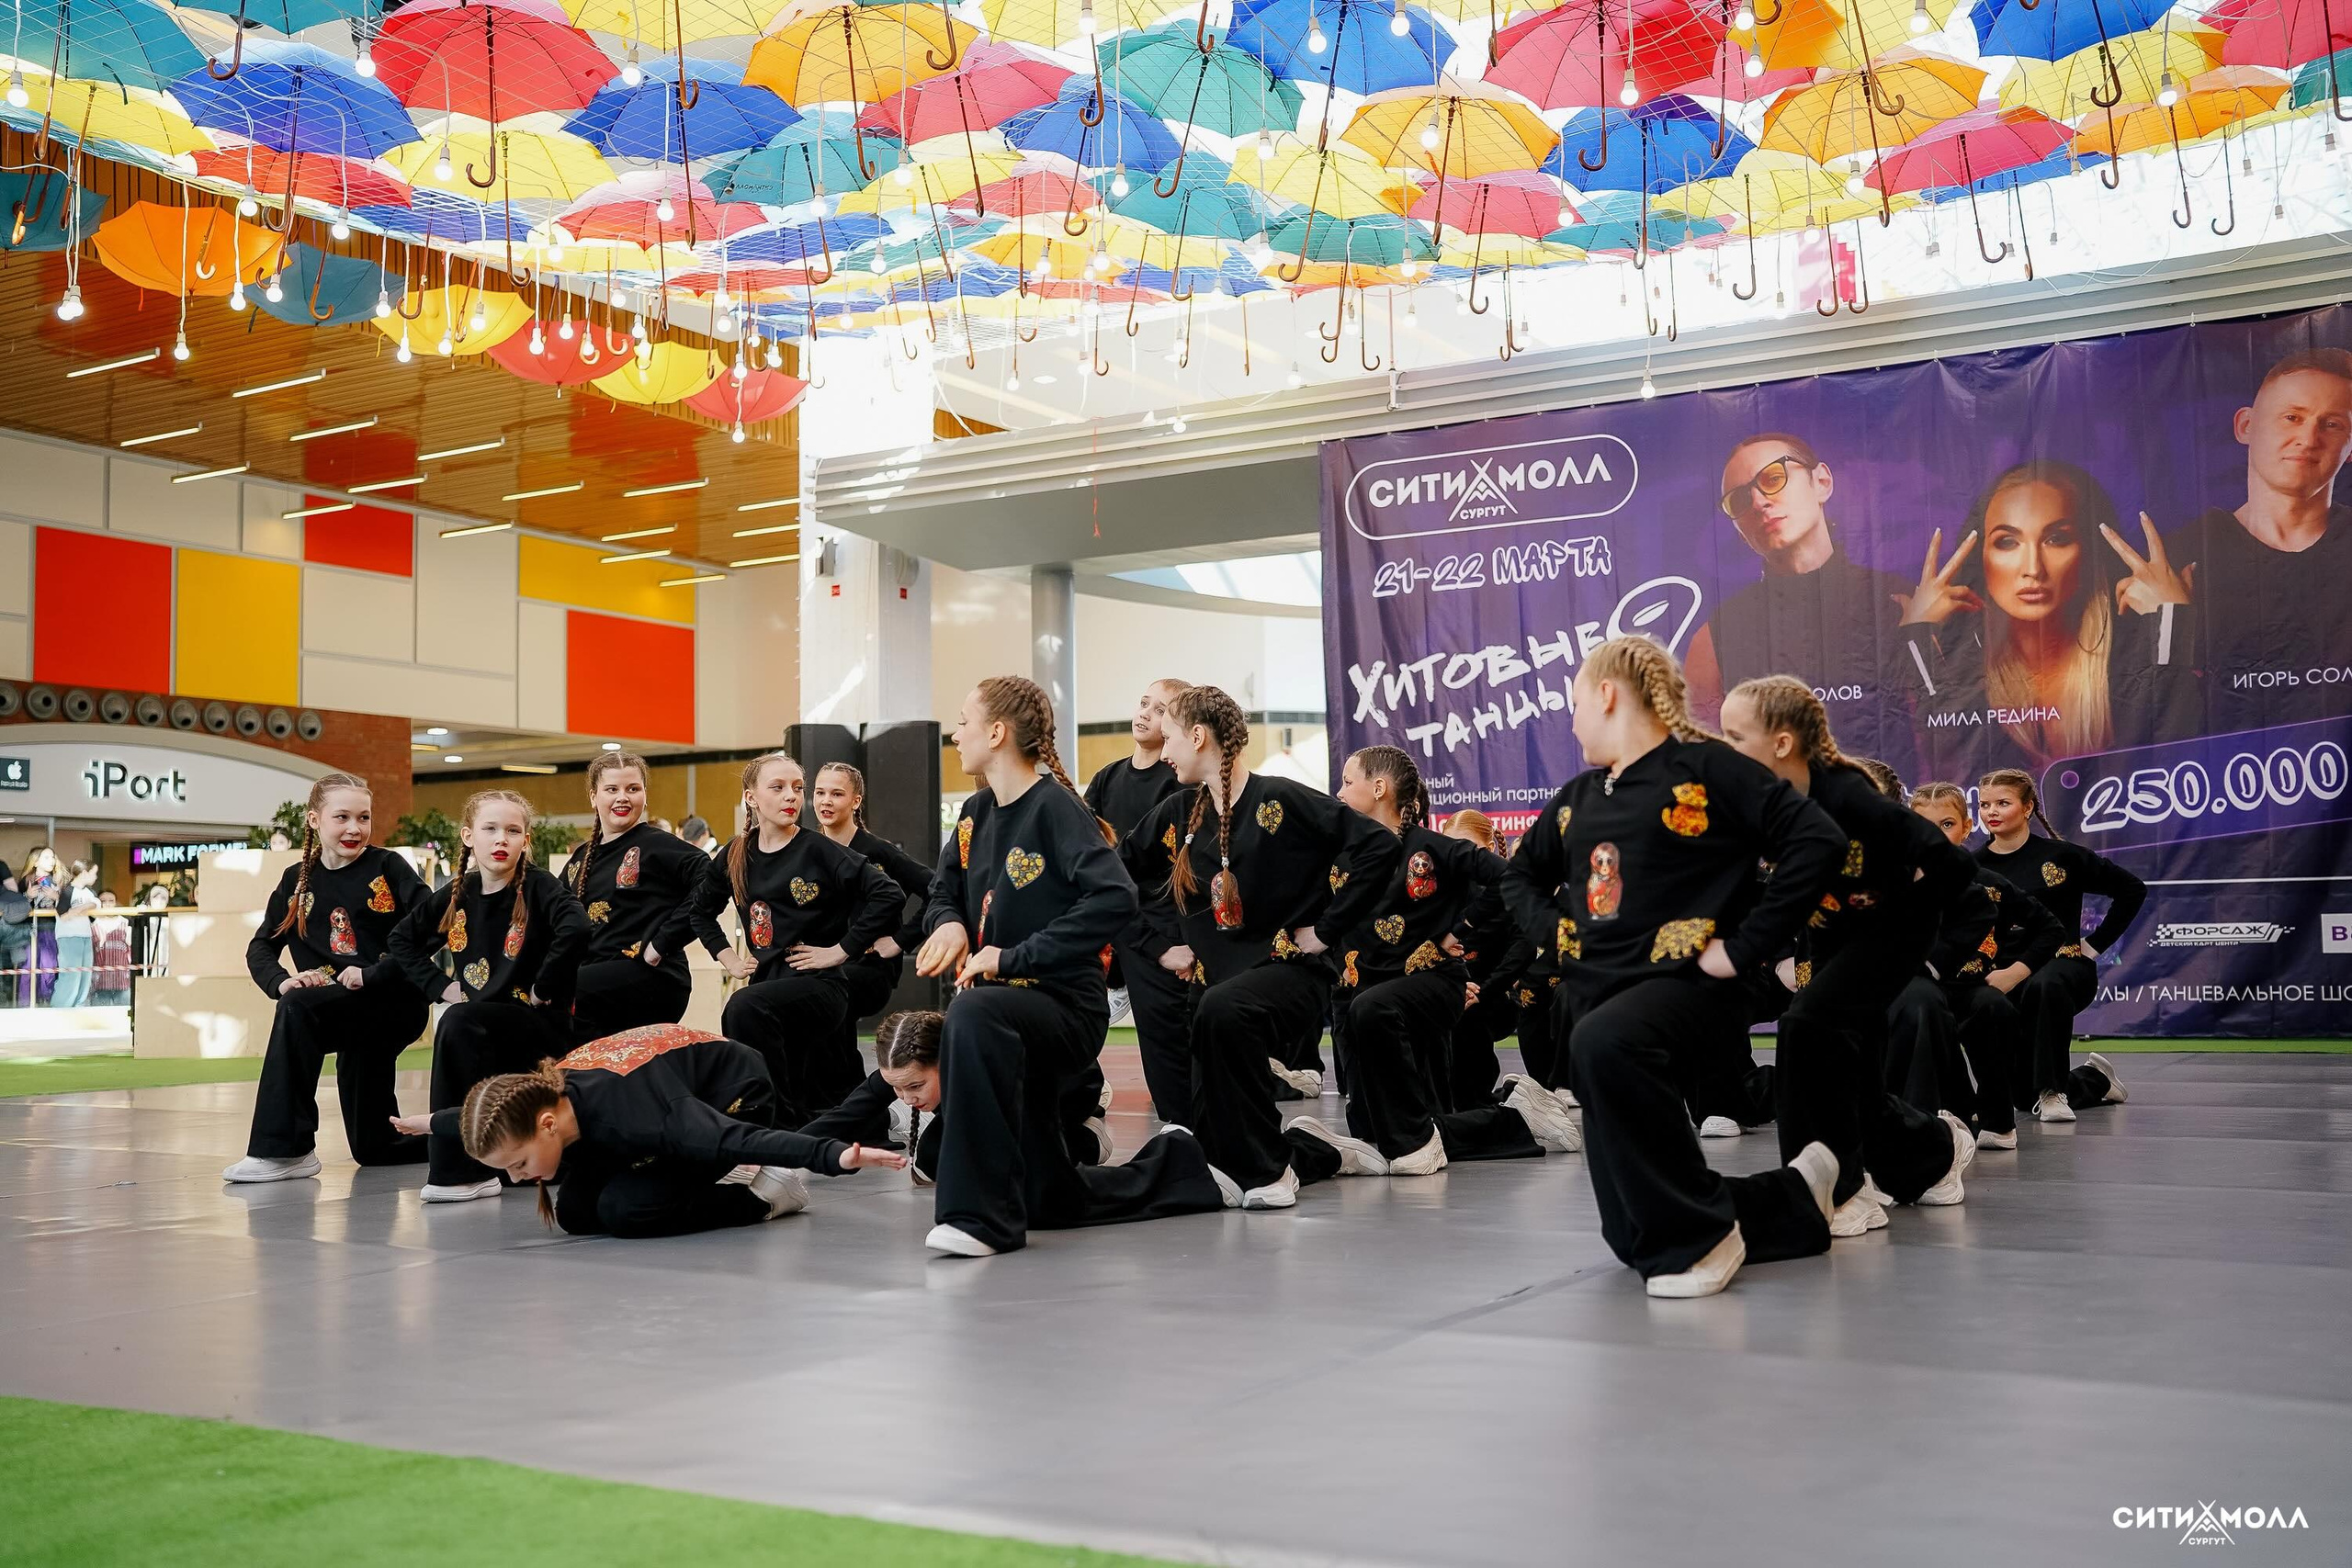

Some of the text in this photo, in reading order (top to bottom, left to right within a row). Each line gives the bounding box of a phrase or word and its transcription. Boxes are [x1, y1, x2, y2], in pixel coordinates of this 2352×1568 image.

[1368, 453, 1612, 508] СИТИ МОЛЛ
[1459, 504, 1507, 521] СУРГУТ
[1372, 535, 1612, 598] 21-22 МАРТА
[2233, 666, 2352, 689] ИГОРЬ СОЛ
[1813, 684, 1863, 703] ОЛОВ
[1927, 705, 2061, 728] МИЛА РЕДИНА
[82, 759, 187, 803] iPort
[2080, 740, 2349, 833] 250.000
[1506, 787, 1563, 804] партне
[141, 845, 186, 864] MARK
[2176, 925, 2265, 936] ФОРСАЖ
[2094, 985, 2129, 1002] ЛЫ
[2149, 985, 2314, 1003] ТАНЦЕВАЛЬНОЕ
[2321, 984, 2352, 1001] ШО
